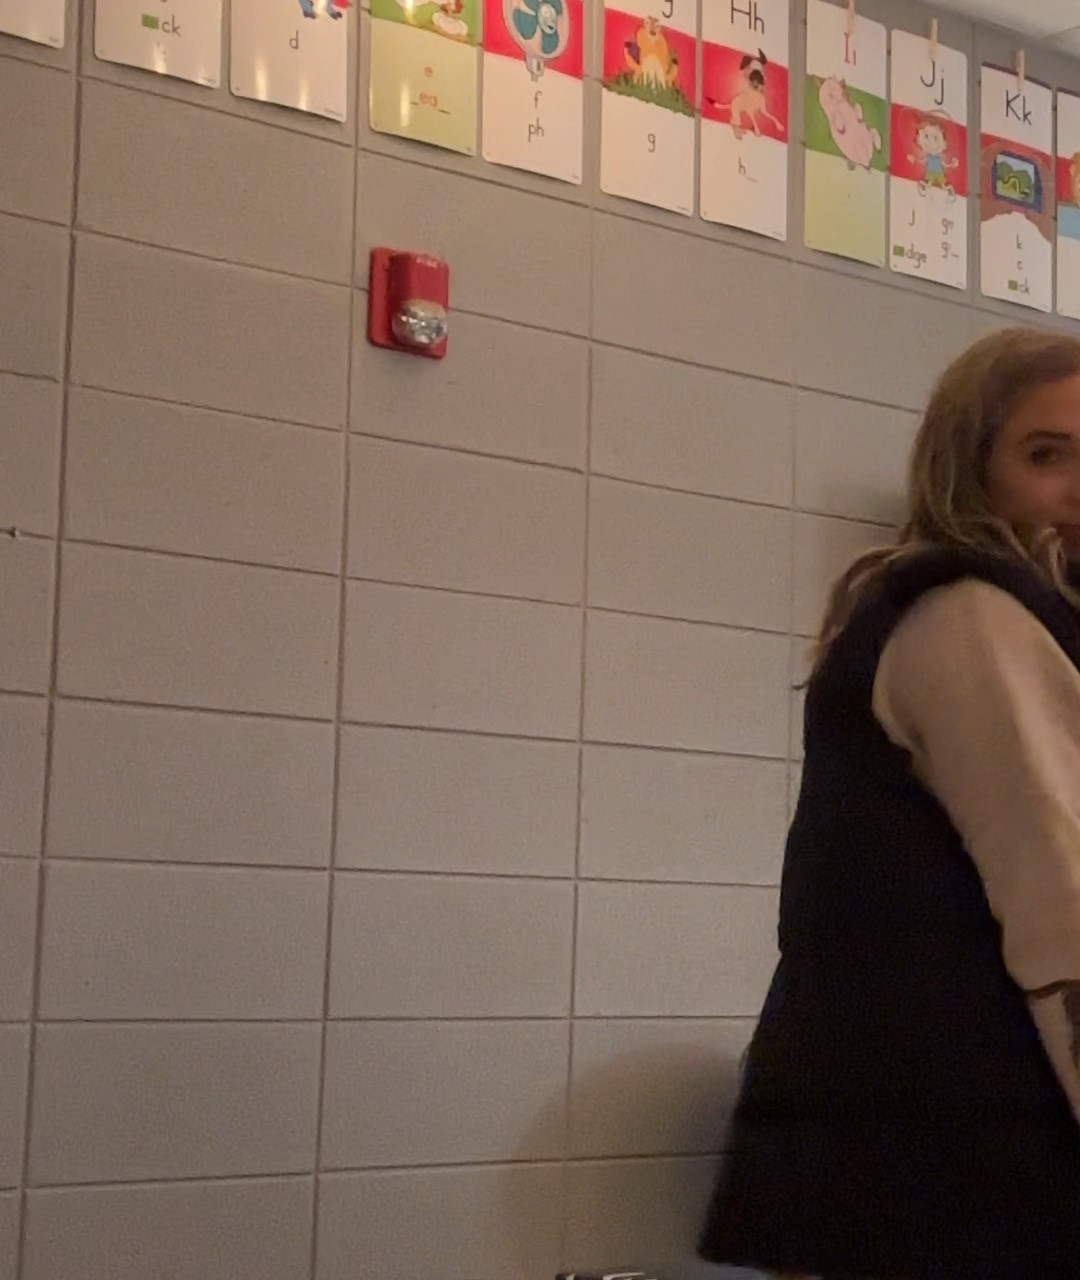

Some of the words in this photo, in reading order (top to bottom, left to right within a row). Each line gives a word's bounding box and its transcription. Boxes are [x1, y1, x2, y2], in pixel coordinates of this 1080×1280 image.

[161, 15, 182, 38] ck
[288, 29, 300, 51] d
[920, 60, 945, 106] Jj
[533, 90, 543, 109] f
[1005, 89, 1033, 126] Kk
[527, 118, 545, 143] ph
[647, 132, 657, 153] g
